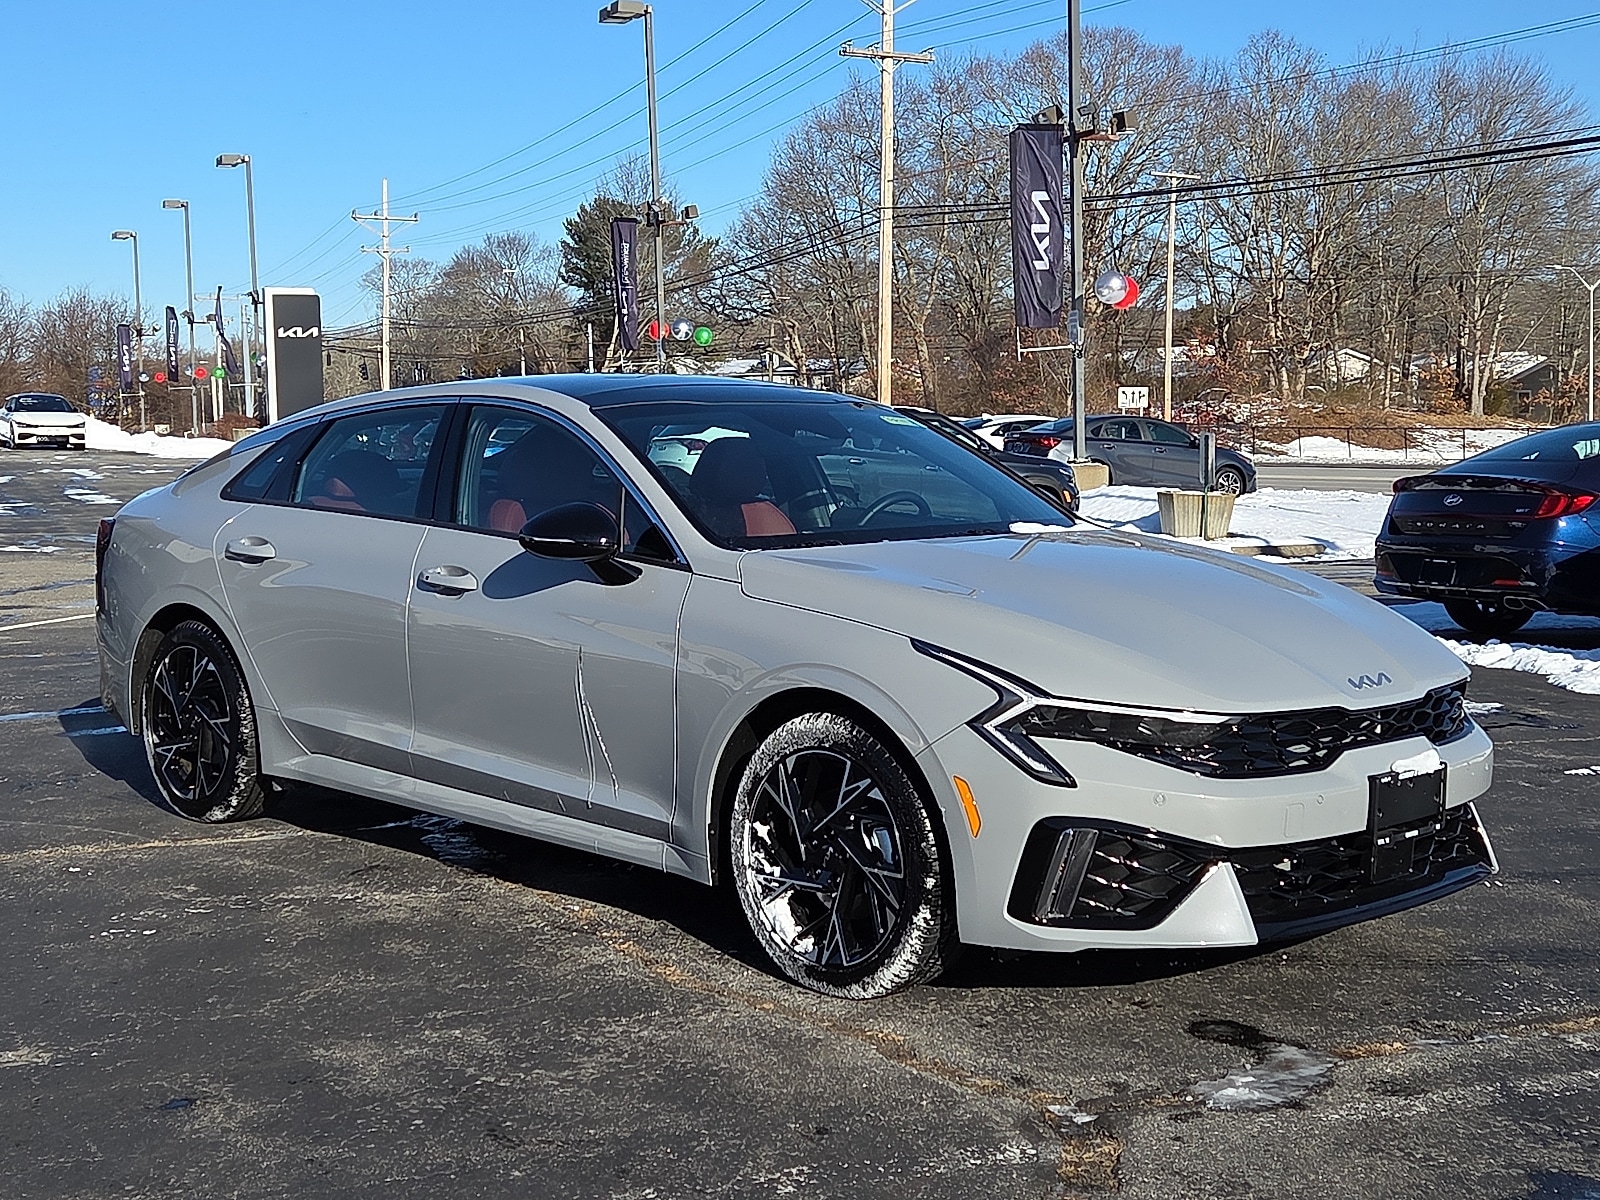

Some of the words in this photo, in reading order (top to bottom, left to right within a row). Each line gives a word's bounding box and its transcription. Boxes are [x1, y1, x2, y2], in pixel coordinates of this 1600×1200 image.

[1031, 190, 1050, 270] KIA
[278, 326, 319, 338] KIA
[1347, 670, 1392, 690] KIA
